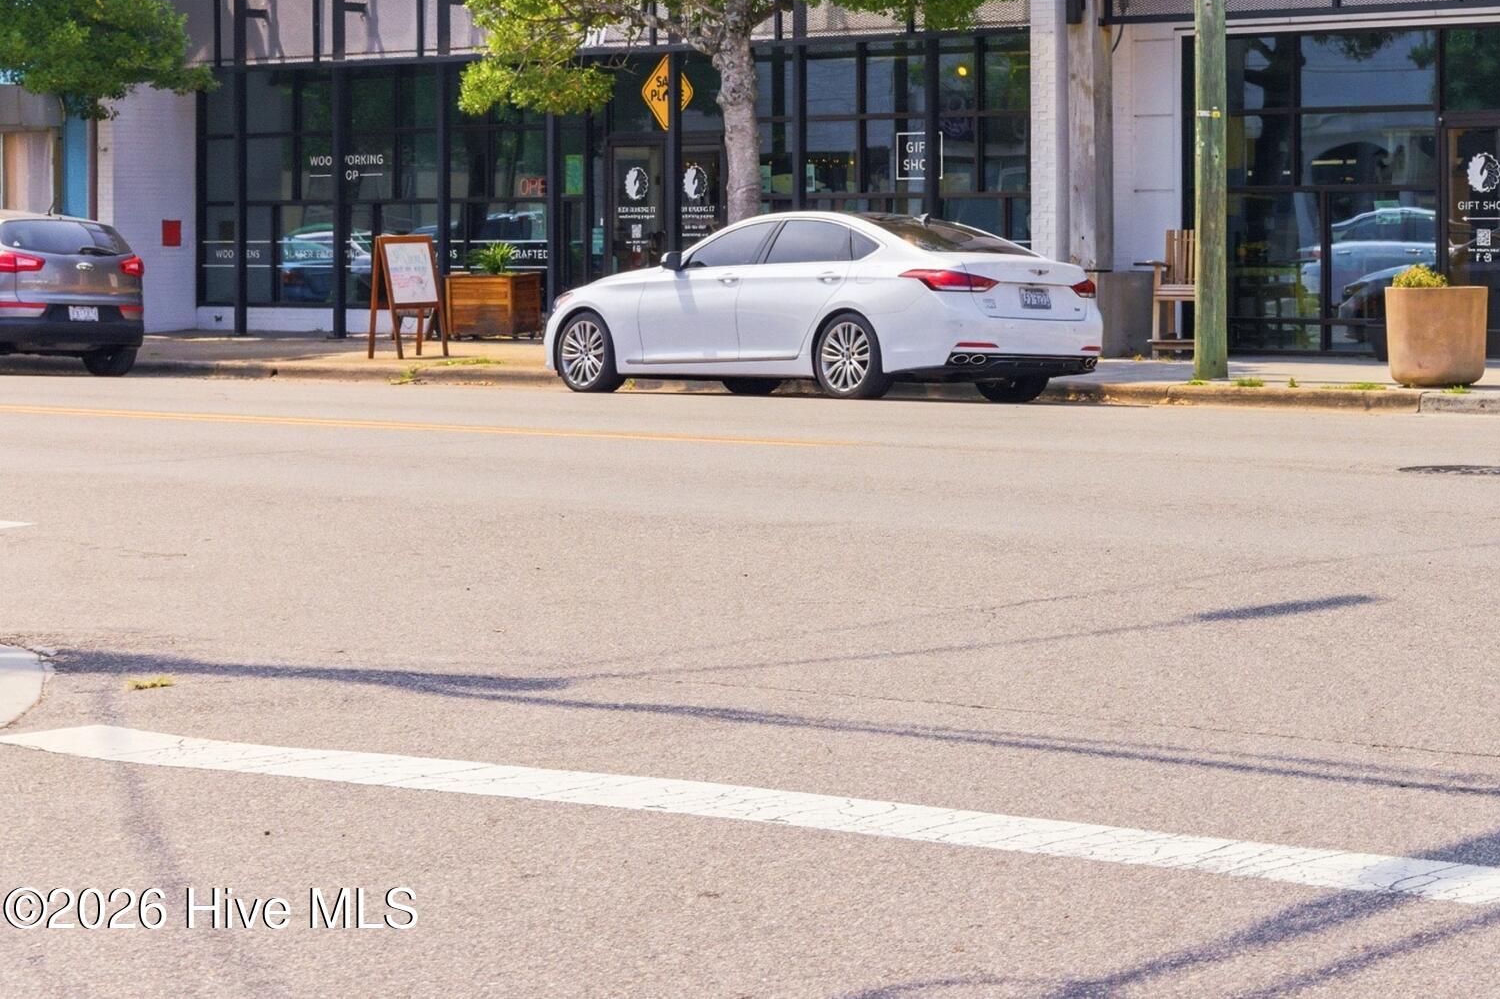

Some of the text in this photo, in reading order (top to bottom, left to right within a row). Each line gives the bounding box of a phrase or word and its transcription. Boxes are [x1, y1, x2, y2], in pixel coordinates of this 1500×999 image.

[905, 141, 926, 154] GIF
[903, 158, 926, 171] SHO
[520, 176, 546, 196] OPE
[1457, 200, 1480, 211] GIFT
